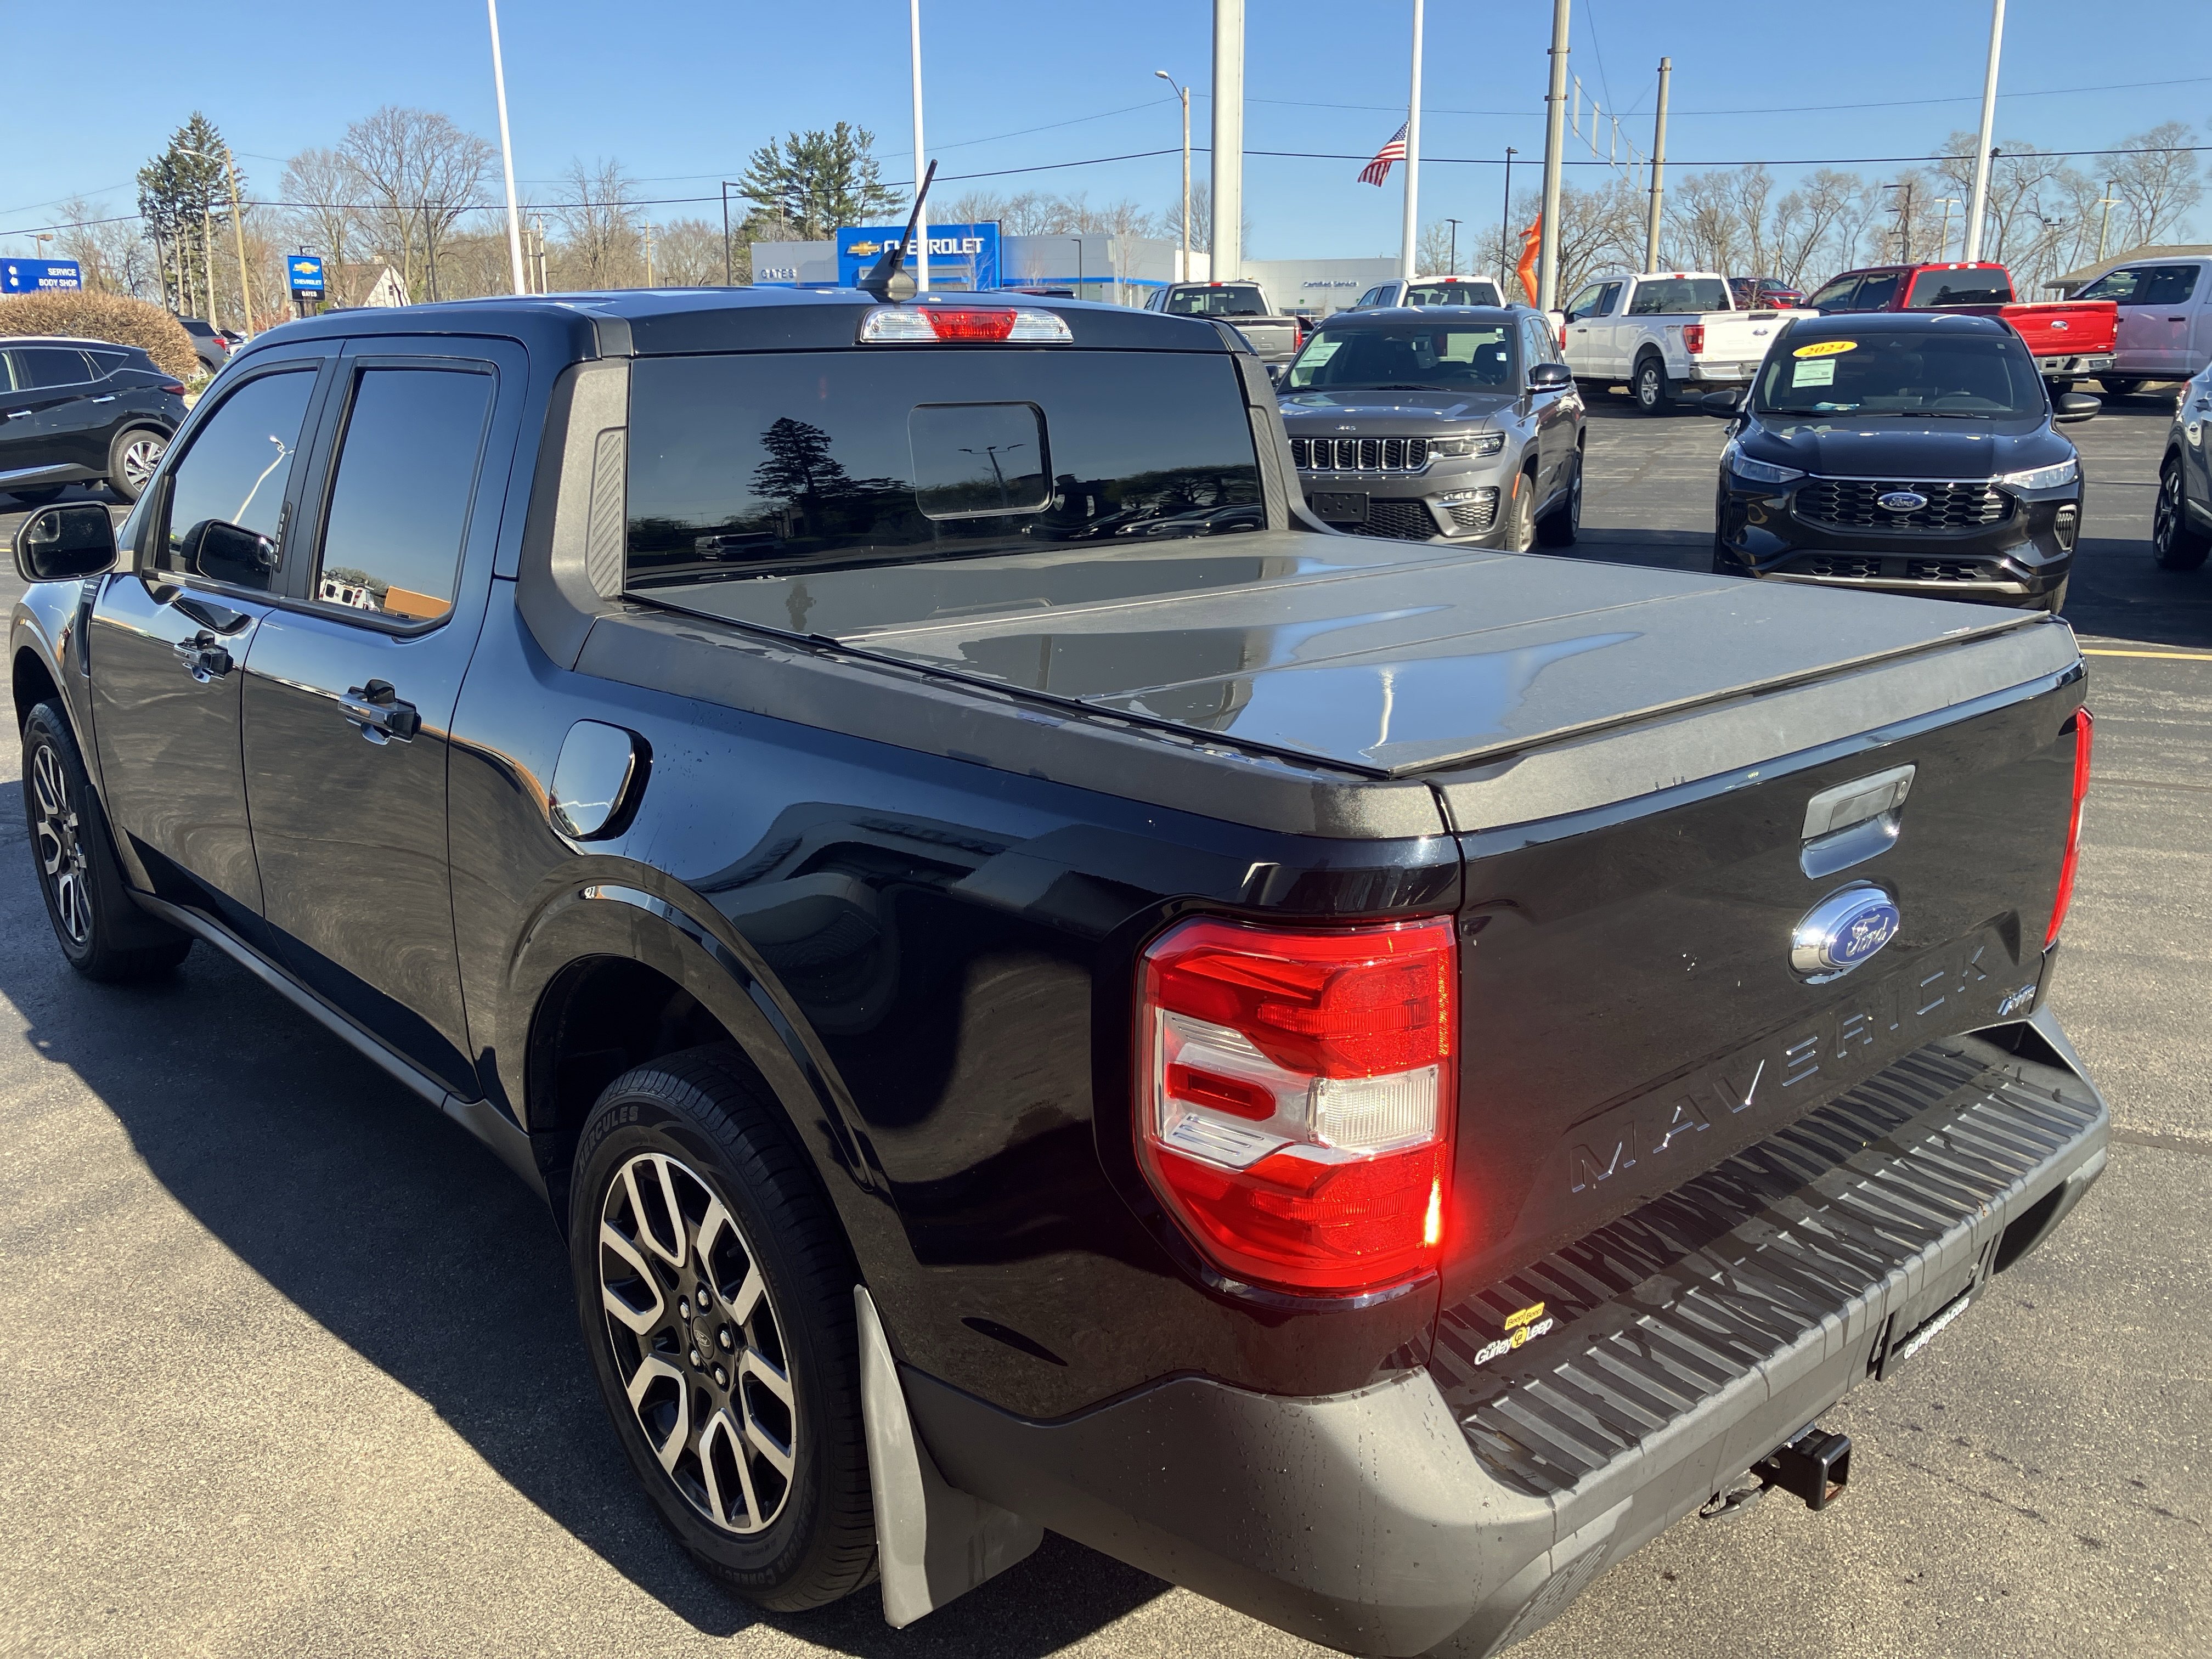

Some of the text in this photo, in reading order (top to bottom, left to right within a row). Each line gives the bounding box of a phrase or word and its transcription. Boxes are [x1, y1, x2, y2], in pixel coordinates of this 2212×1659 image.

[884, 238, 985, 255] CEROLET
[47, 268, 77, 276] SERVICE
[761, 268, 796, 279] GATES
[38, 278, 78, 287] BODY SHOP
[1804, 343, 1846, 356] 2024
[1846, 913, 1889, 958] Ford
[1569, 945, 1988, 1194] MAVERICK
[579, 1105, 639, 1175] HERCULES
[1507, 1312, 1526, 1327] Beep!
[1474, 1336, 1513, 1365] Gurley
[1526, 1318, 1554, 1341] Leep
